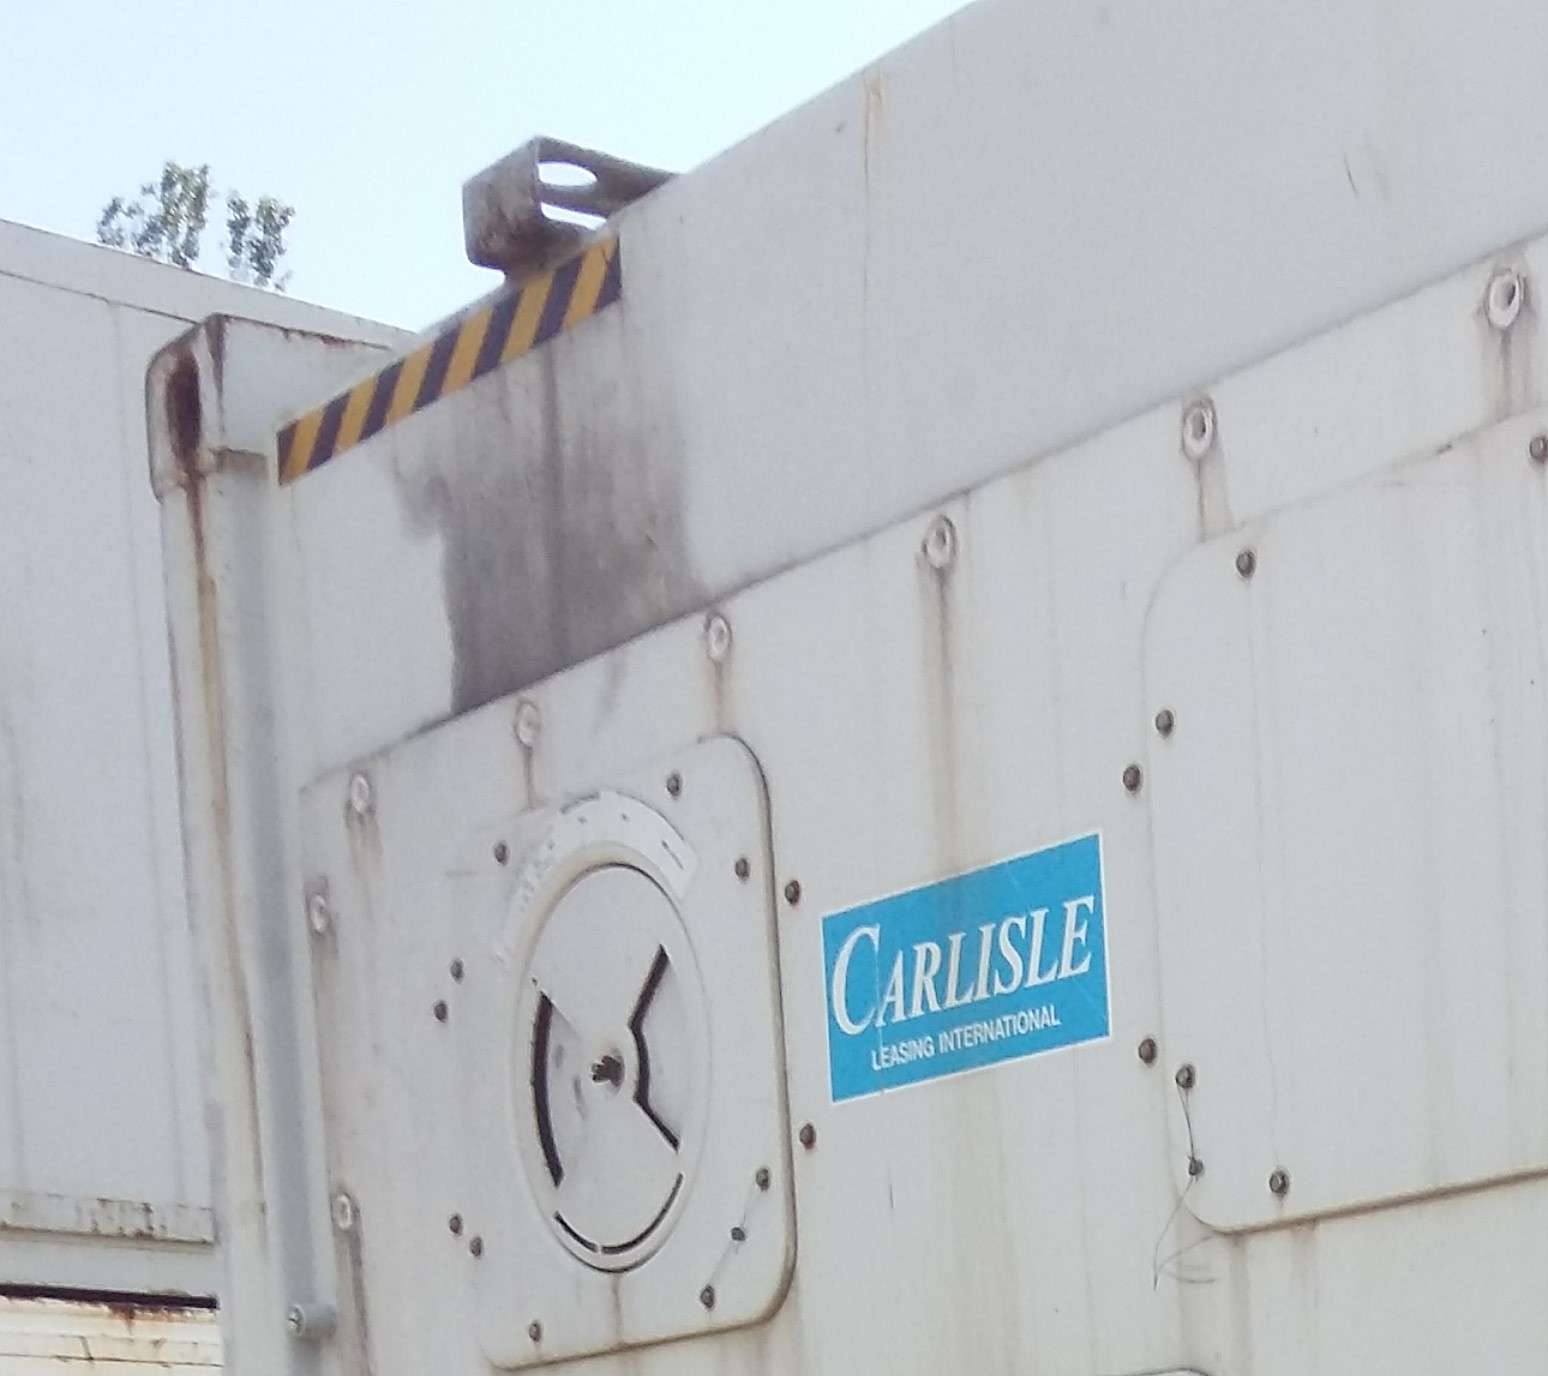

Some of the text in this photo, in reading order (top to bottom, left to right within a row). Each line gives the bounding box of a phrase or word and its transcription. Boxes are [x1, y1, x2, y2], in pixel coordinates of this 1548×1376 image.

[831, 895, 1095, 1036] CARLISLE
[871, 1003, 1061, 1072] LEASING INTERNATIONAL
